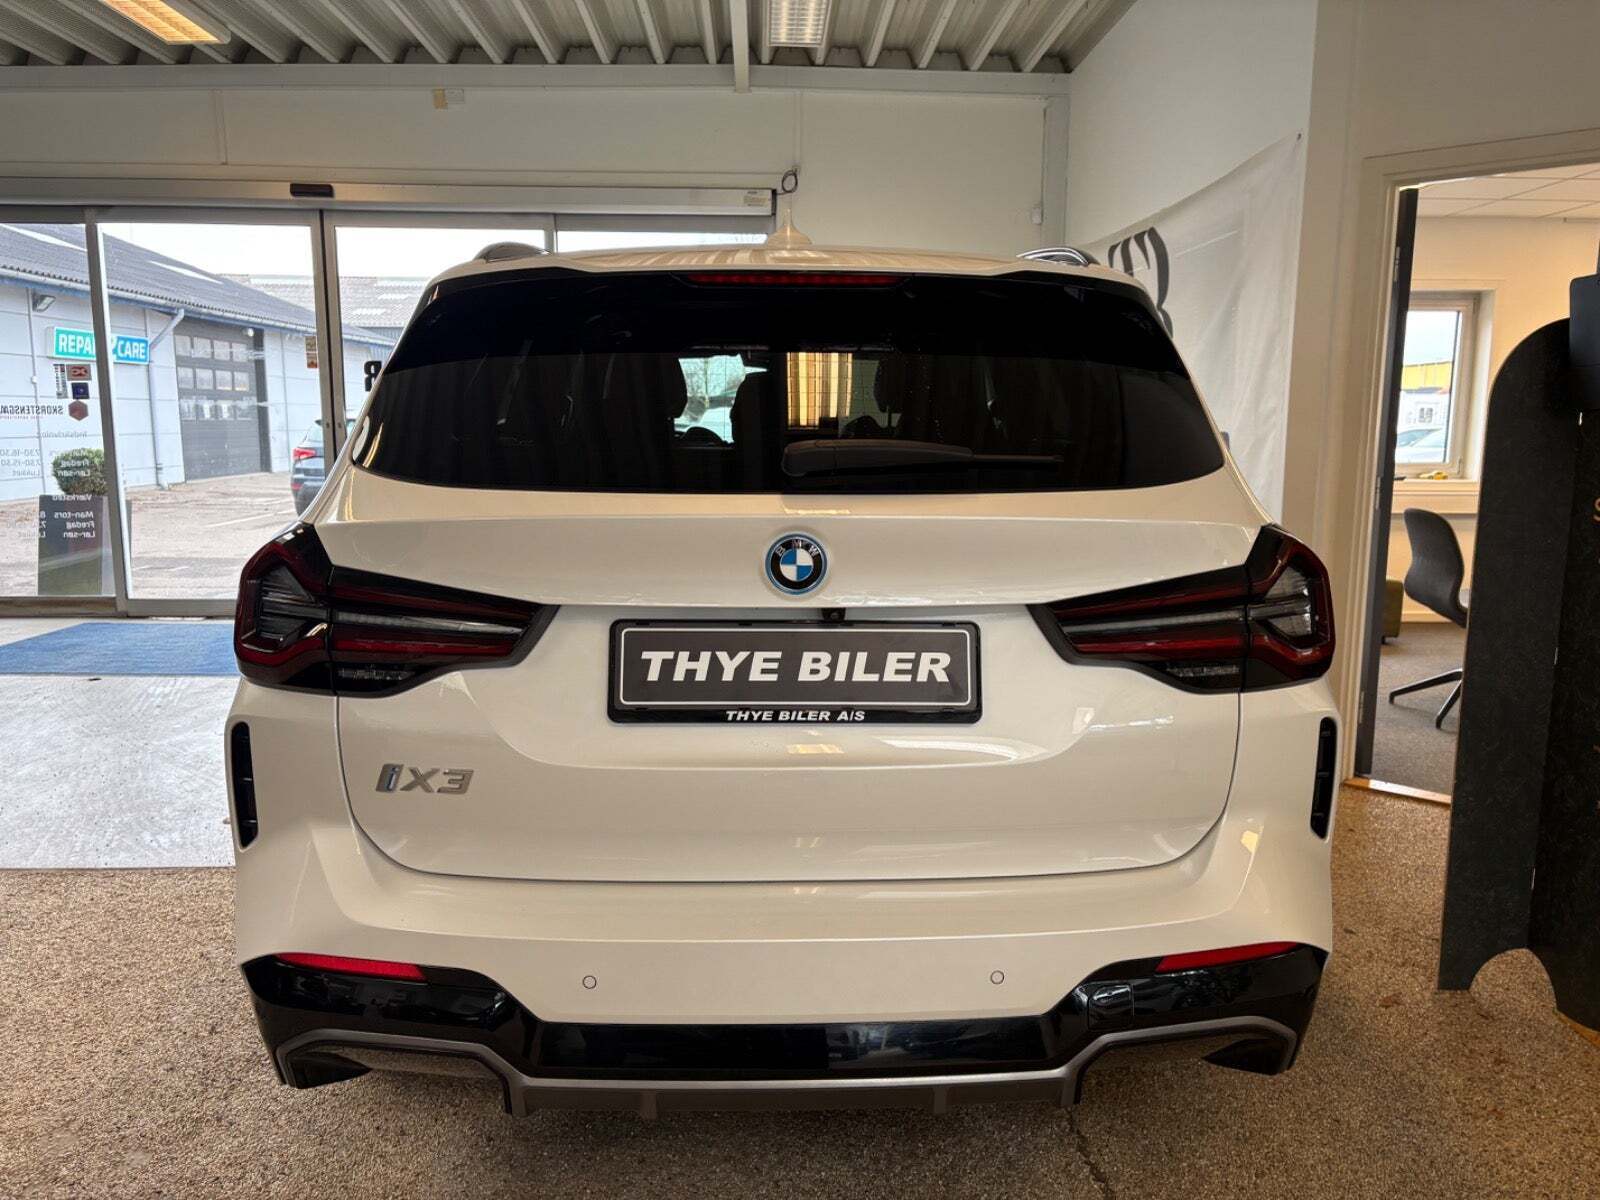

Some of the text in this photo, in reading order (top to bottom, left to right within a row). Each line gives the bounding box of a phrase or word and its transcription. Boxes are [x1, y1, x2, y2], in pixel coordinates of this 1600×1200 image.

[117, 341, 146, 359] CARE
[641, 650, 951, 683] THYE BILER
[725, 710, 773, 721] THYE
[778, 710, 831, 721] BILER
[375, 763, 474, 795] iX3
